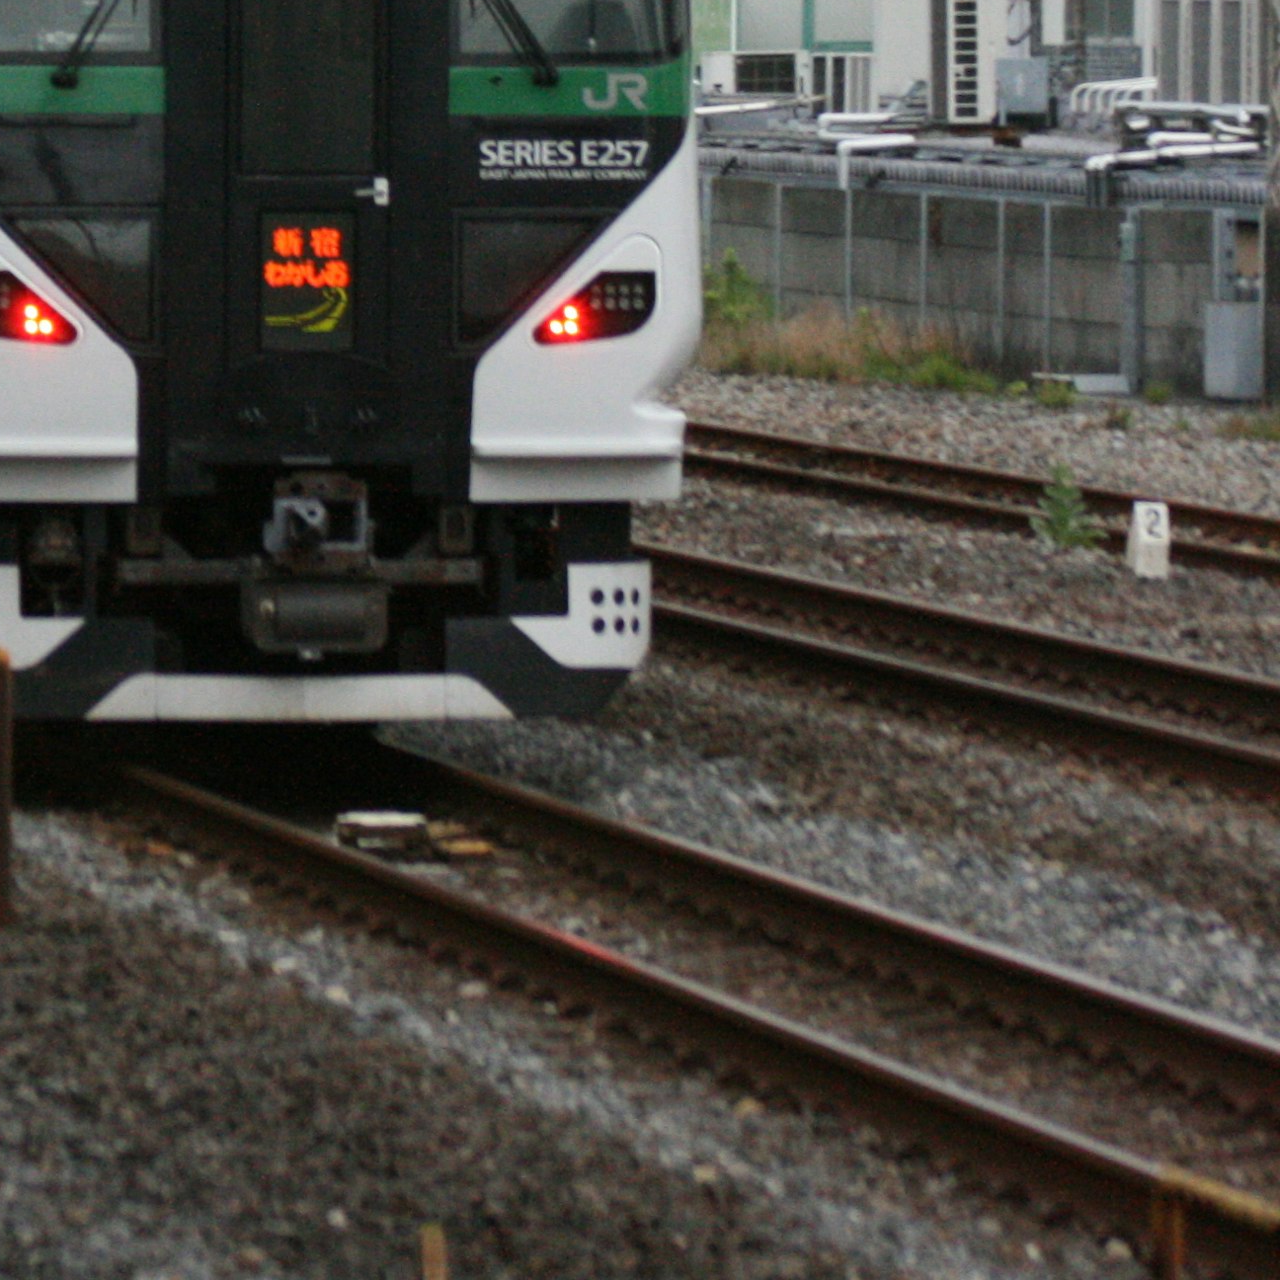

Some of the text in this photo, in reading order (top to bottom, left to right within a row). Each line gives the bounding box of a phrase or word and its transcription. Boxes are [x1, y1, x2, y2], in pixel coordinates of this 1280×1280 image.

[582, 73, 648, 111] JR
[479, 139, 650, 168] SERIES E257
[479, 168, 648, 181] EAST JAPAN RAILWAY COMPANY
[272, 226, 342, 258] 新宿
[263, 259, 351, 288] わかしお
[1145, 508, 1164, 539] 2
